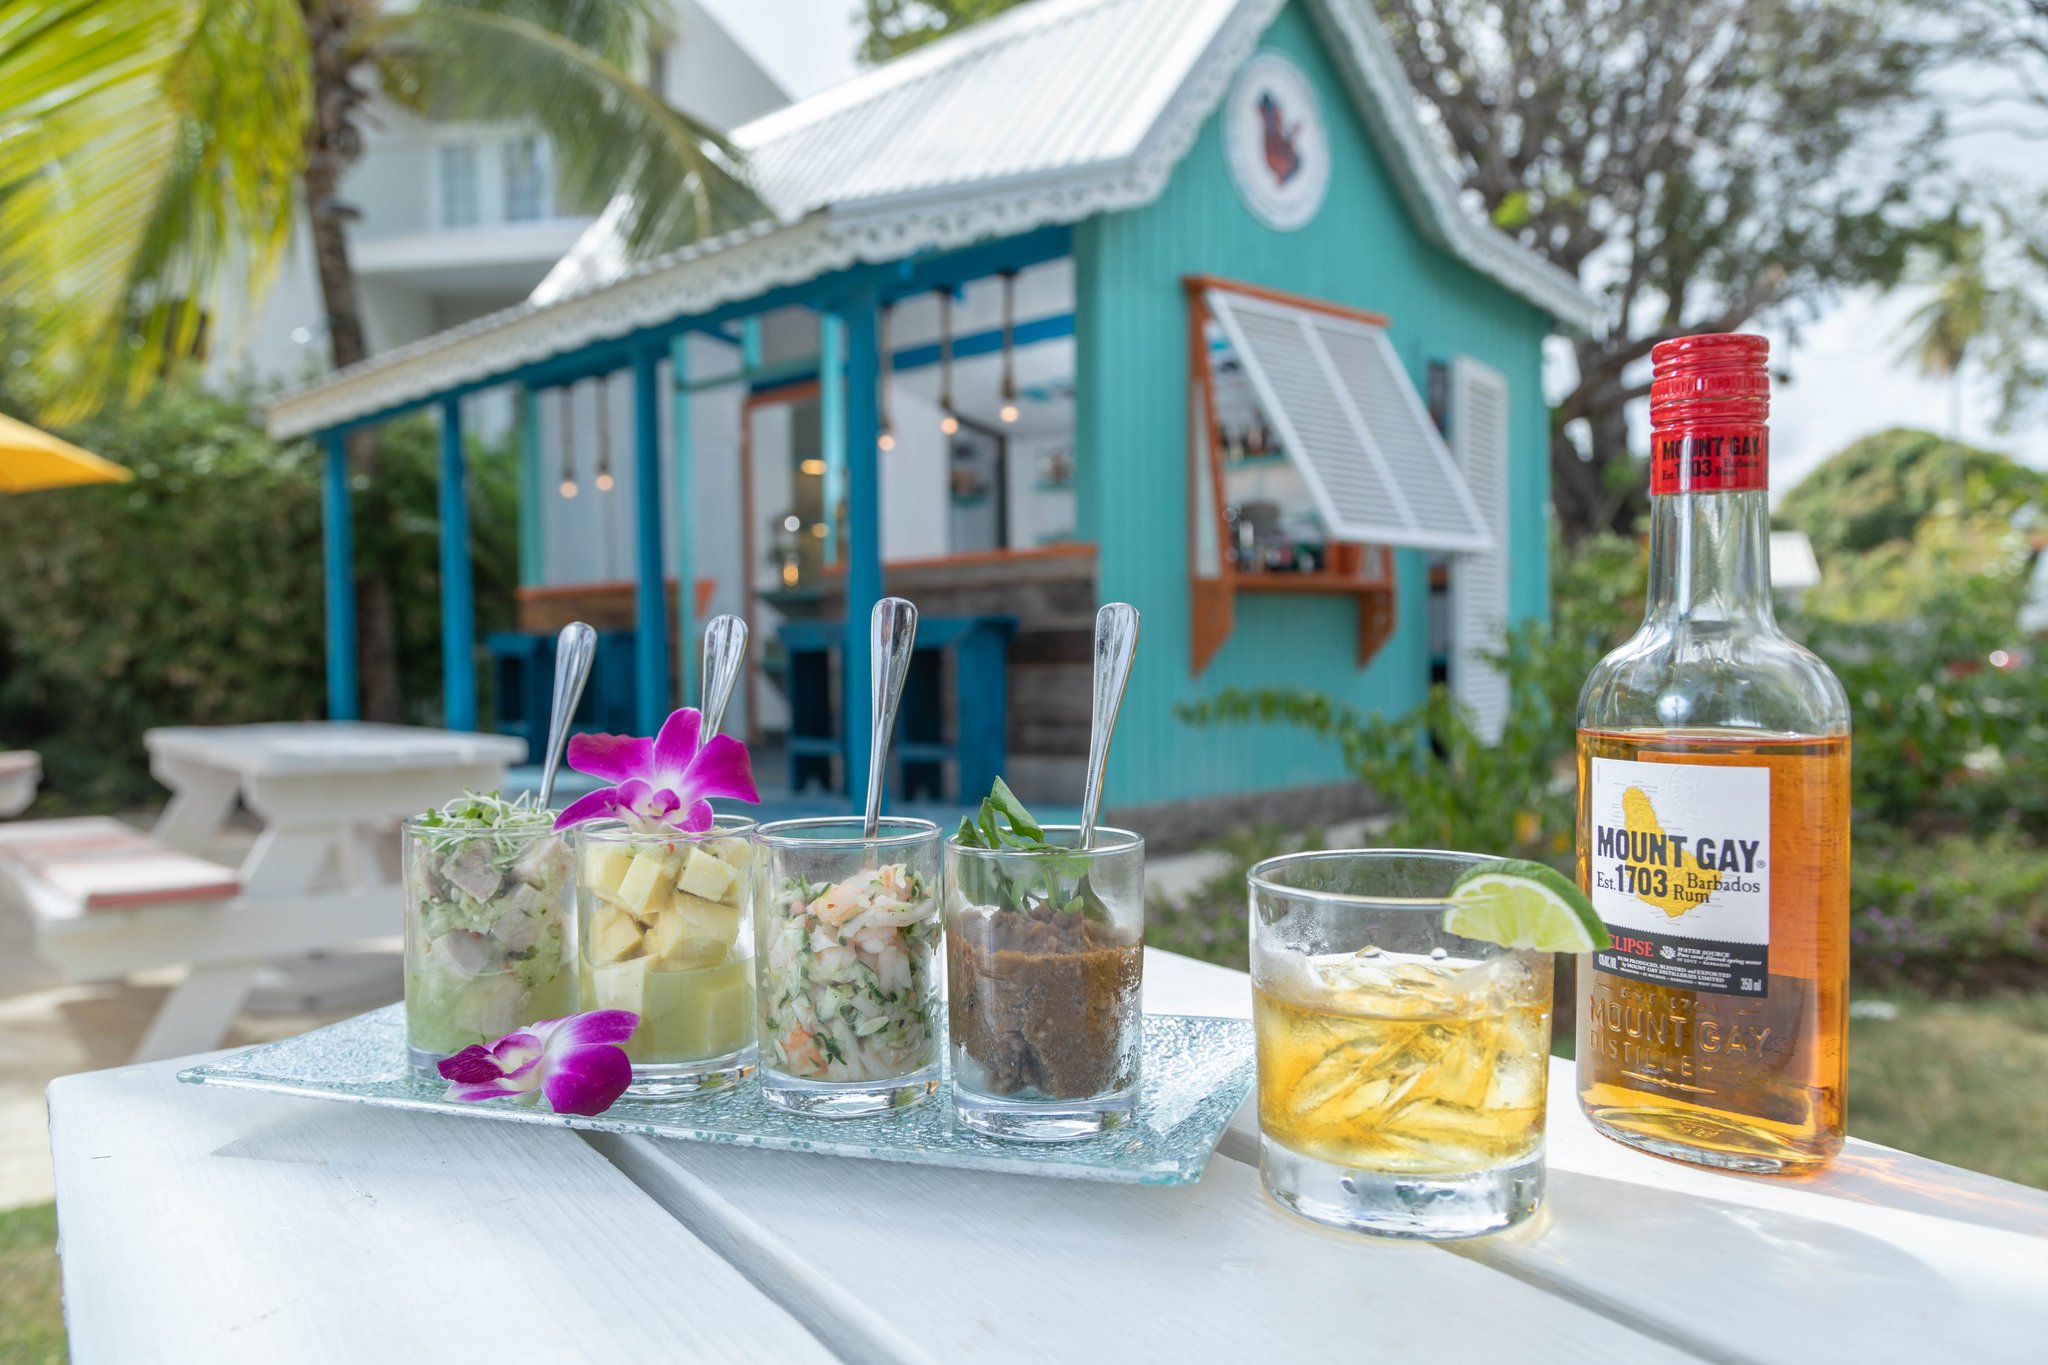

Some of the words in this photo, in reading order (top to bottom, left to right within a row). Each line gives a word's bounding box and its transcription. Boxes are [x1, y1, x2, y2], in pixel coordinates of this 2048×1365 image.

[1675, 459, 1711, 478] 103
[1597, 825, 1687, 868] MOUNT
[1597, 871, 1616, 890] Est.
[1615, 864, 1668, 897] 1703
[1687, 872, 1761, 893] Barbados
[1673, 884, 1711, 904] Rum
[1607, 934, 1655, 957] CLIPSE
[1590, 994, 1687, 1048] MOUNT
[1699, 1021, 1772, 1059] GAY
